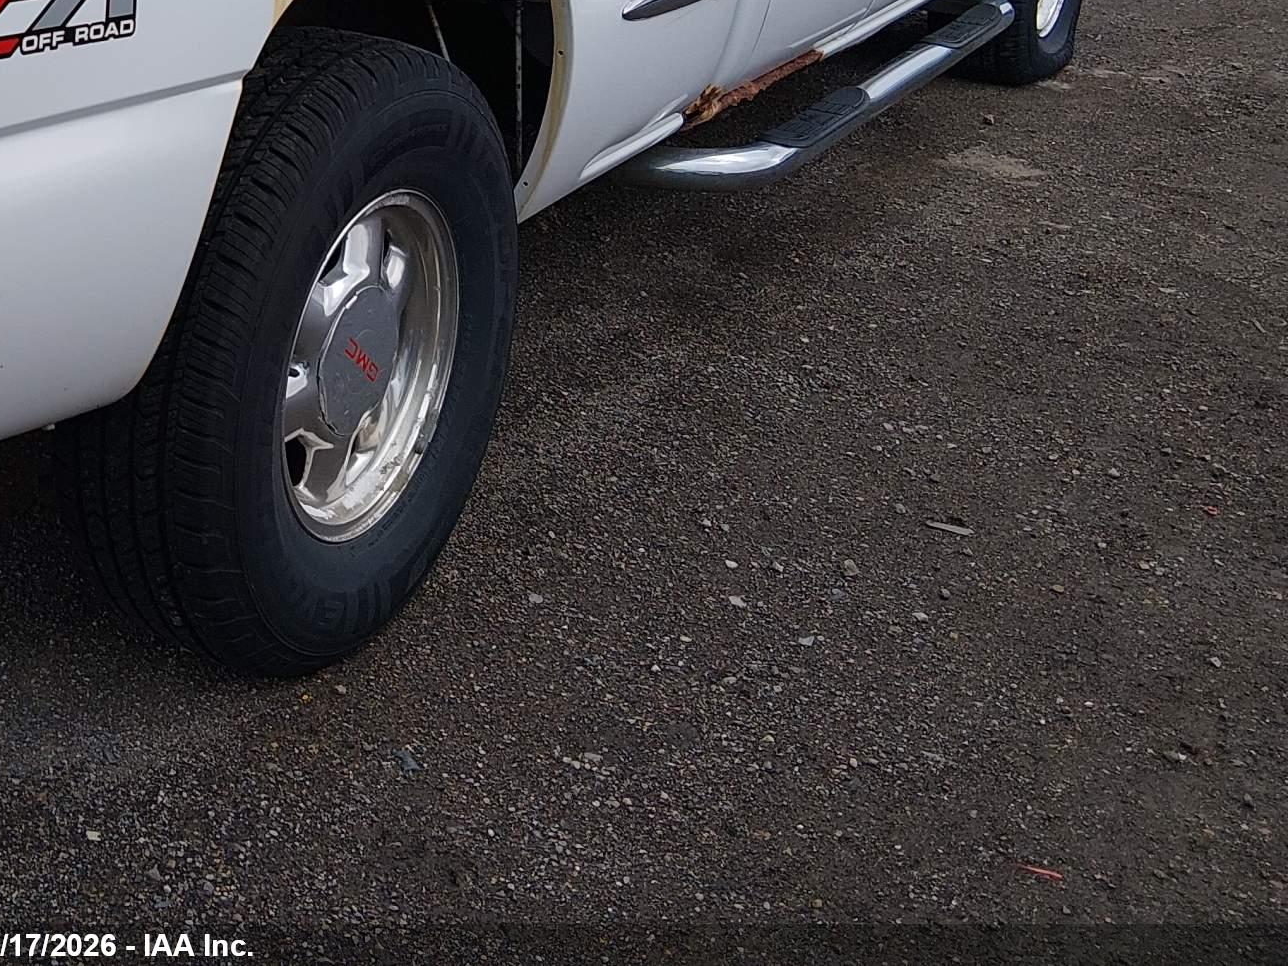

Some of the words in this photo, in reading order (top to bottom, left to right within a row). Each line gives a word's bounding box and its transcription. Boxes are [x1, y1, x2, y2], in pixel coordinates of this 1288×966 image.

[21, 30, 66, 53] OFF
[74, 19, 135, 43] ROAD
[343, 336, 379, 384] GMC
